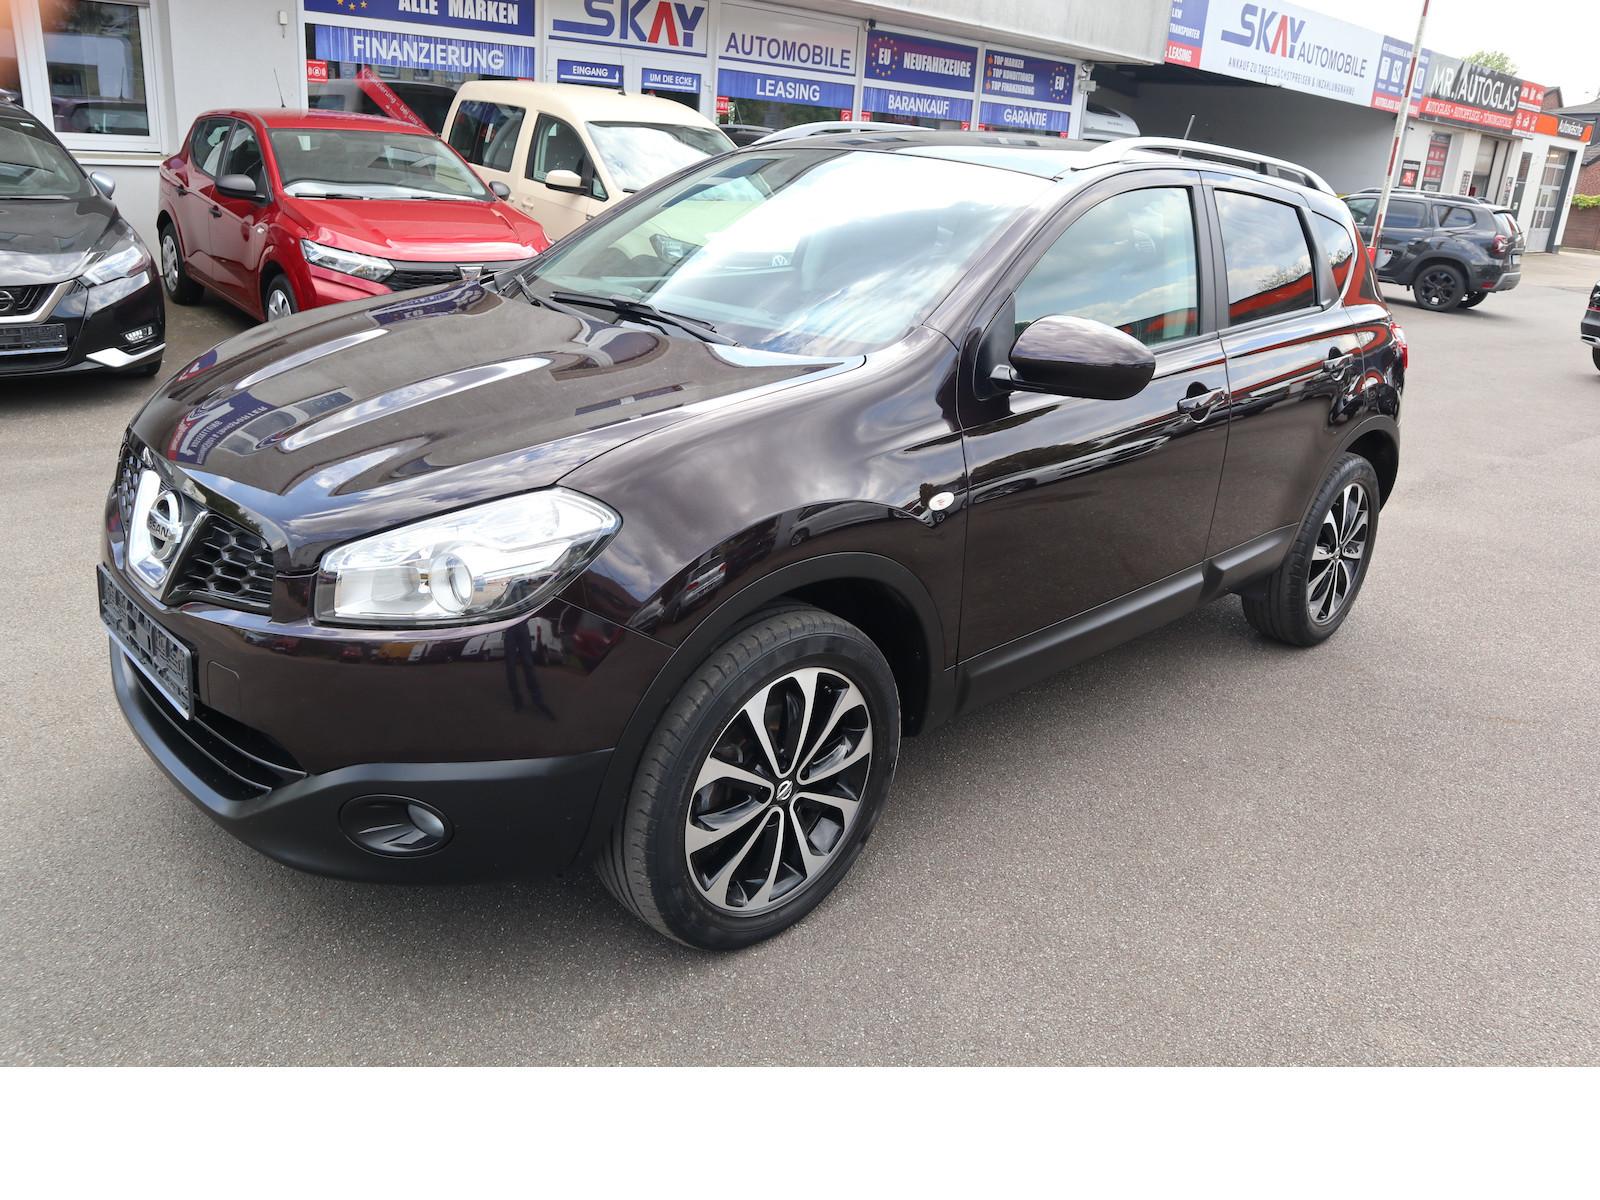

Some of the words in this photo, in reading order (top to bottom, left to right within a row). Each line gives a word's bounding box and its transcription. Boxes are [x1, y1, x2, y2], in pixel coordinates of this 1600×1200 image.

[398, 0, 439, 15] ALLE
[448, 0, 519, 25] MARKEN
[553, 0, 707, 48] SKAY
[1170, 22, 1200, 39] TRANSPORTER
[725, 32, 851, 70] AUTOMOBILE
[1221, 3, 1306, 59] SKAY
[1298, 41, 1368, 79] AUTOMOBILE
[353, 35, 505, 70] FINANZIERUNG
[878, 47, 892, 65] EU
[903, 51, 972, 78] NEUFAHRZEUGE
[994, 55, 1004, 65] TOP
[1004, 57, 1025, 69] MARKEN
[1168, 45, 1192, 62] LEASING
[573, 65, 608, 77] EINGANG
[992, 68, 1003, 78] TOP
[1228, 56, 1249, 72] ANKAUF
[1250, 63, 1258, 73] ZU
[650, 73, 661, 82] UM
[662, 74, 674, 84] DIE
[675, 75, 693, 86] ECKE
[991, 81, 1002, 91] TOP
[1001, 82, 1035, 95] FINANZIERUNG
[1054, 76, 1065, 91] EU
[756, 78, 821, 102] LEASING
[1458, 73, 1519, 112] AUTOGLAS
[887, 94, 950, 115] BARANKAUF
[1003, 107, 1048, 127] GARANTIE
[148, 517, 169, 538] SSAN
